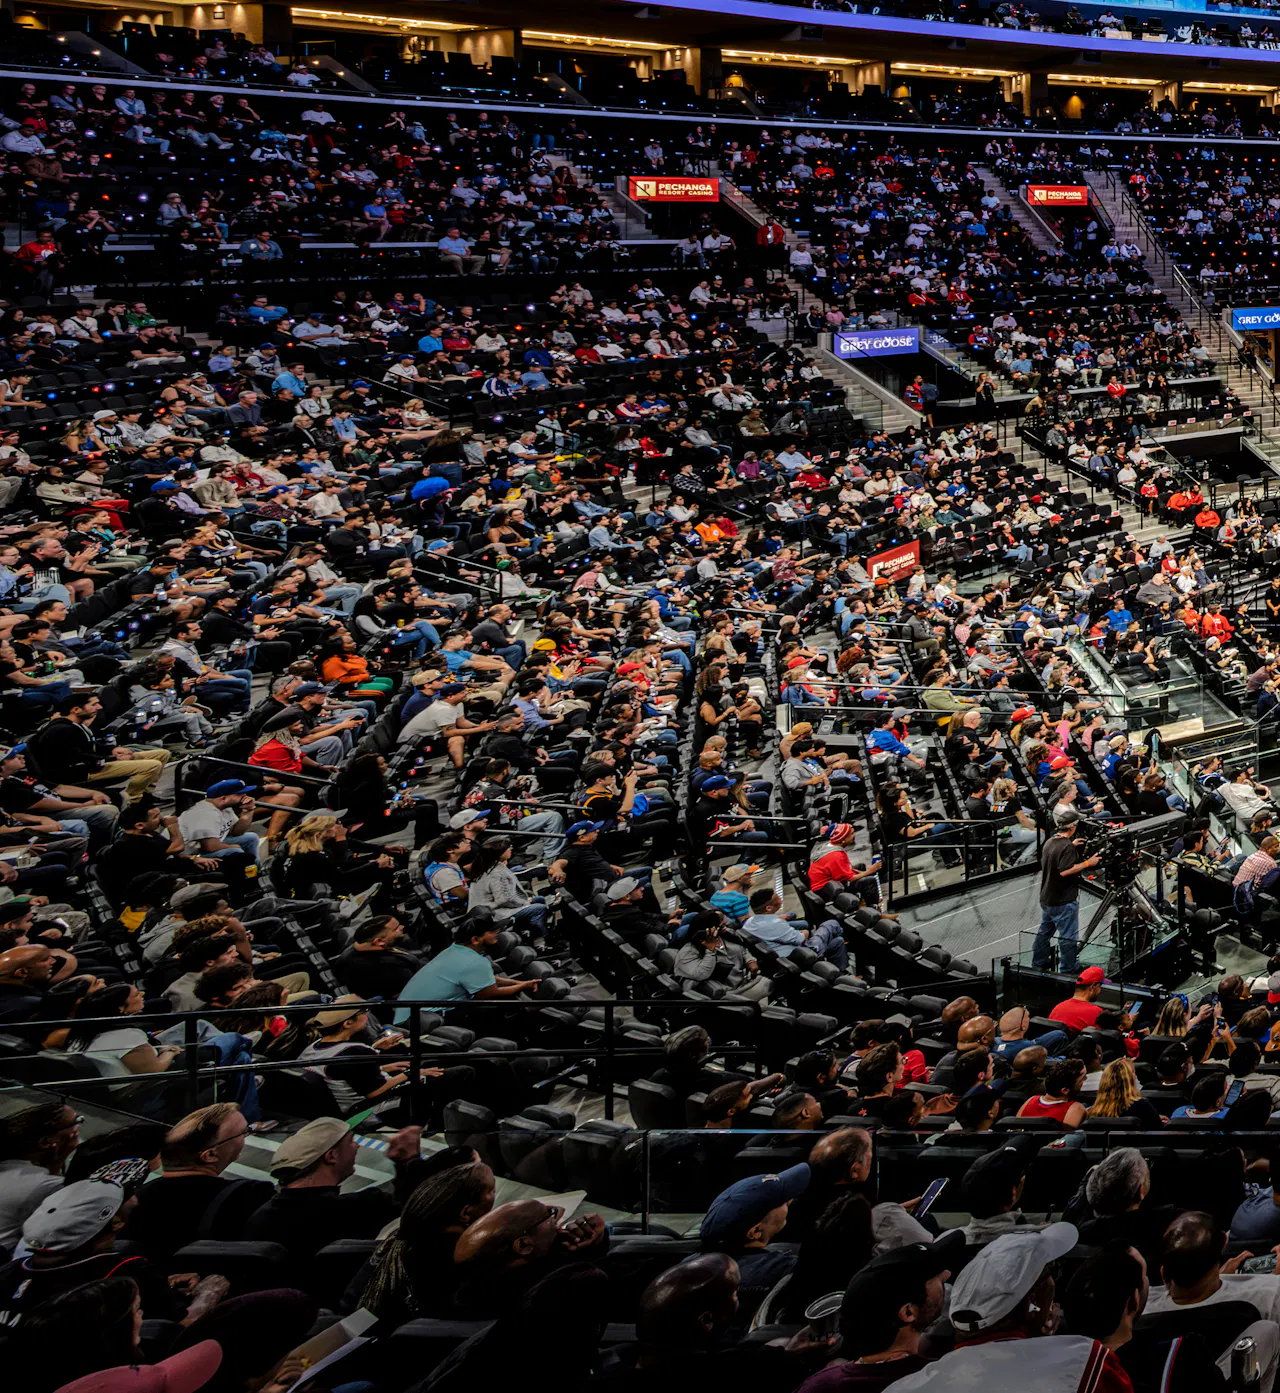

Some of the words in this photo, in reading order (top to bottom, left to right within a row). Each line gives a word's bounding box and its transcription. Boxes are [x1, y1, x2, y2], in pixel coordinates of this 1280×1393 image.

[659, 183, 713, 192] PECHANGA
[1238, 316, 1261, 325] GREY
[840, 339, 878, 352] GREY
[881, 337, 914, 349] GOOSE
[884, 551, 915, 569] PECHANGA
